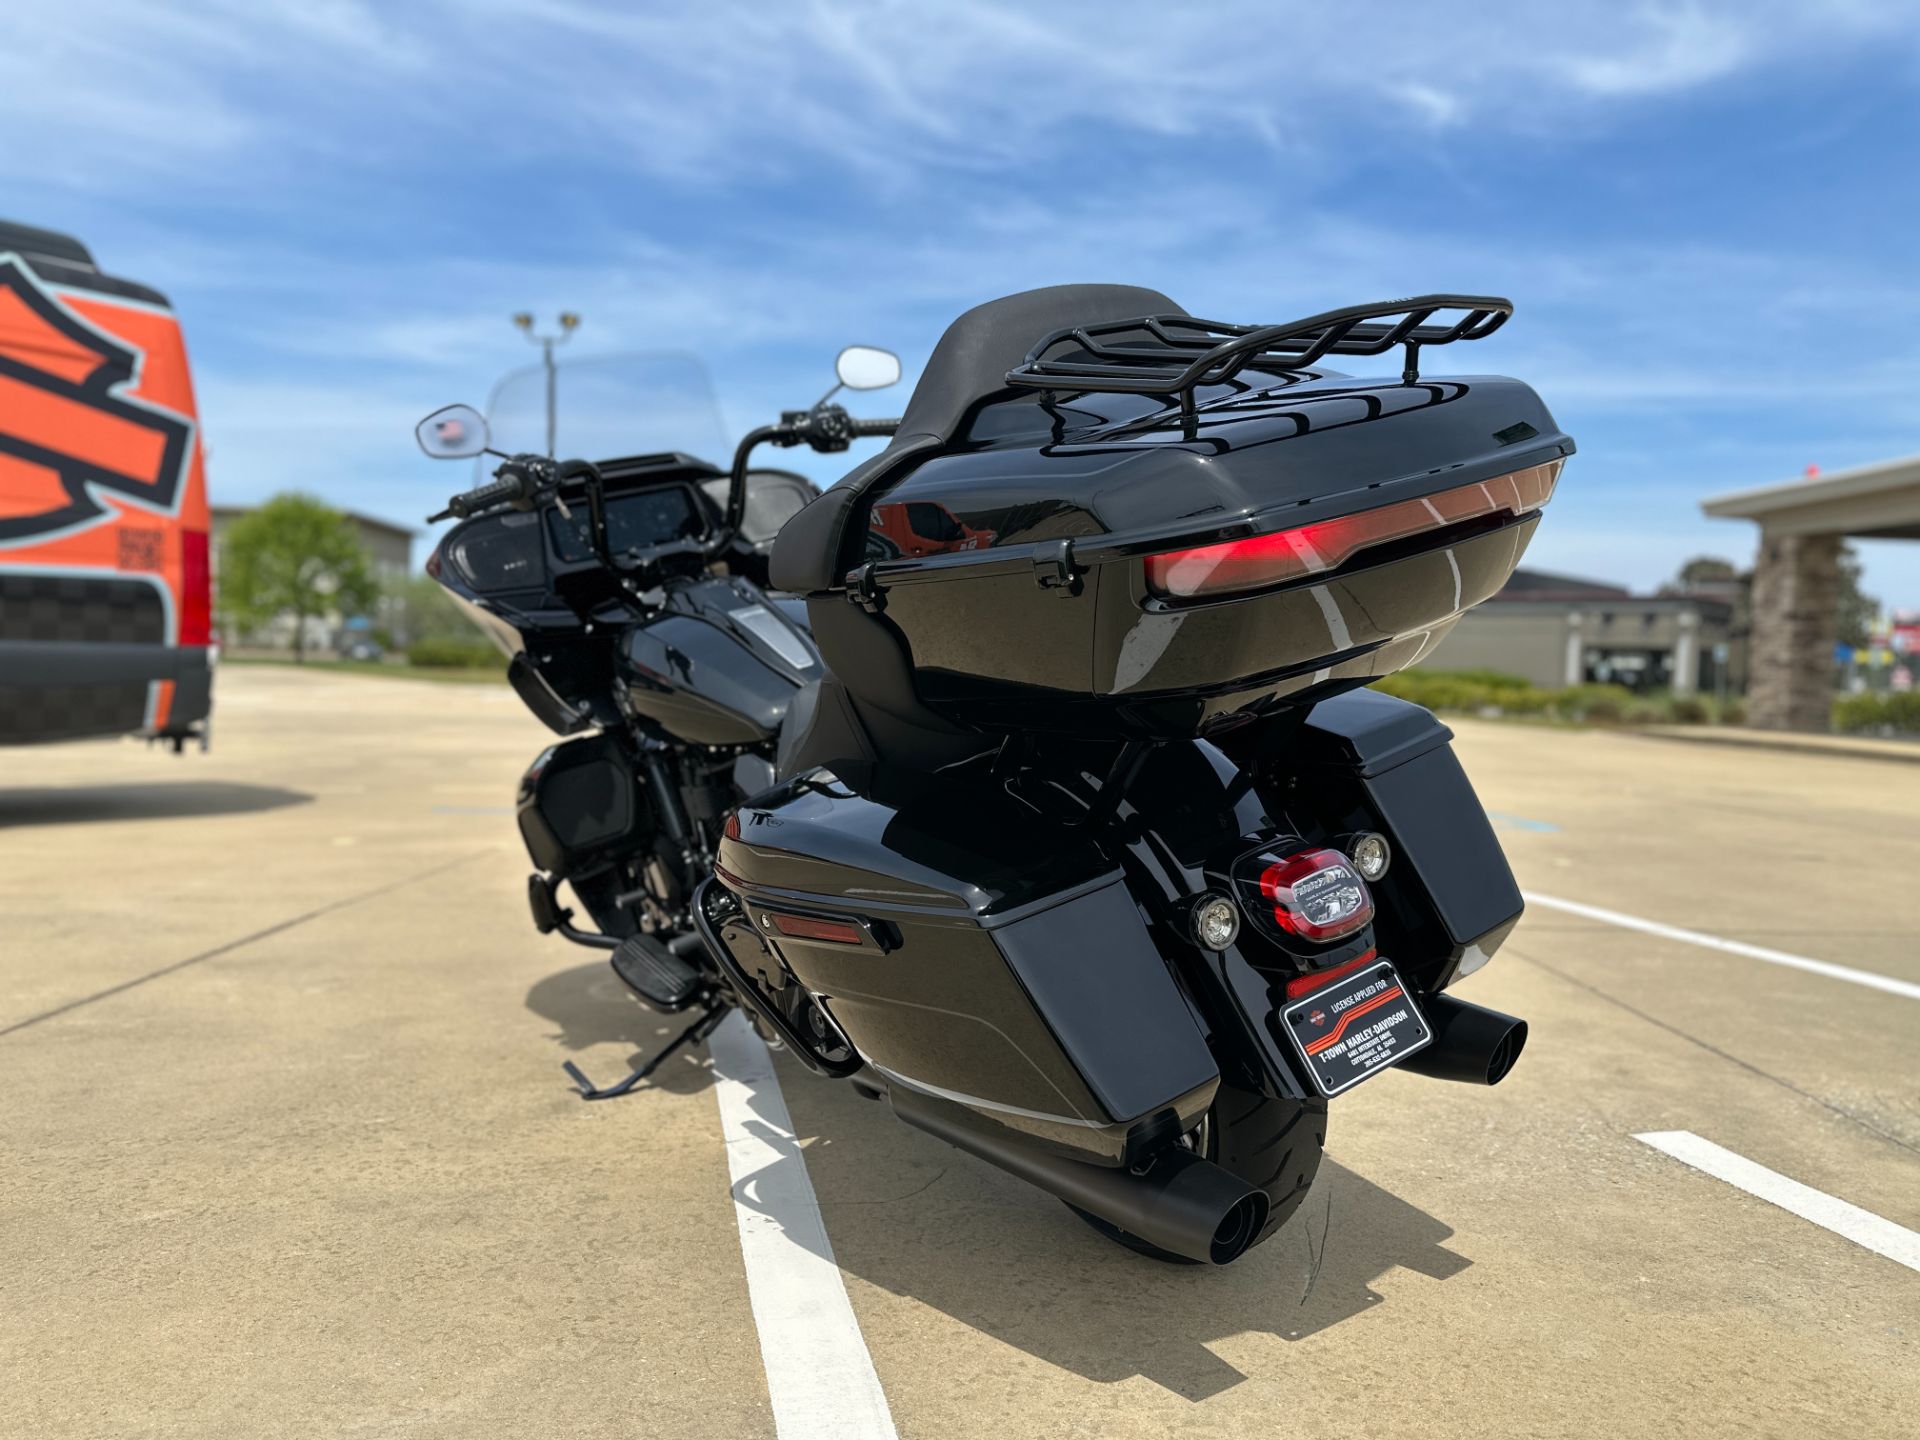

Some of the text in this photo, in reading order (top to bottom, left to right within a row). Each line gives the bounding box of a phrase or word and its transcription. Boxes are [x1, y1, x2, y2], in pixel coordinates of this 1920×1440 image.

[1331, 979, 1389, 1014] LICENSE APPLIED FOR
[1318, 1009, 1408, 1063] T-TOWN HARLEY-DAVIDSON
